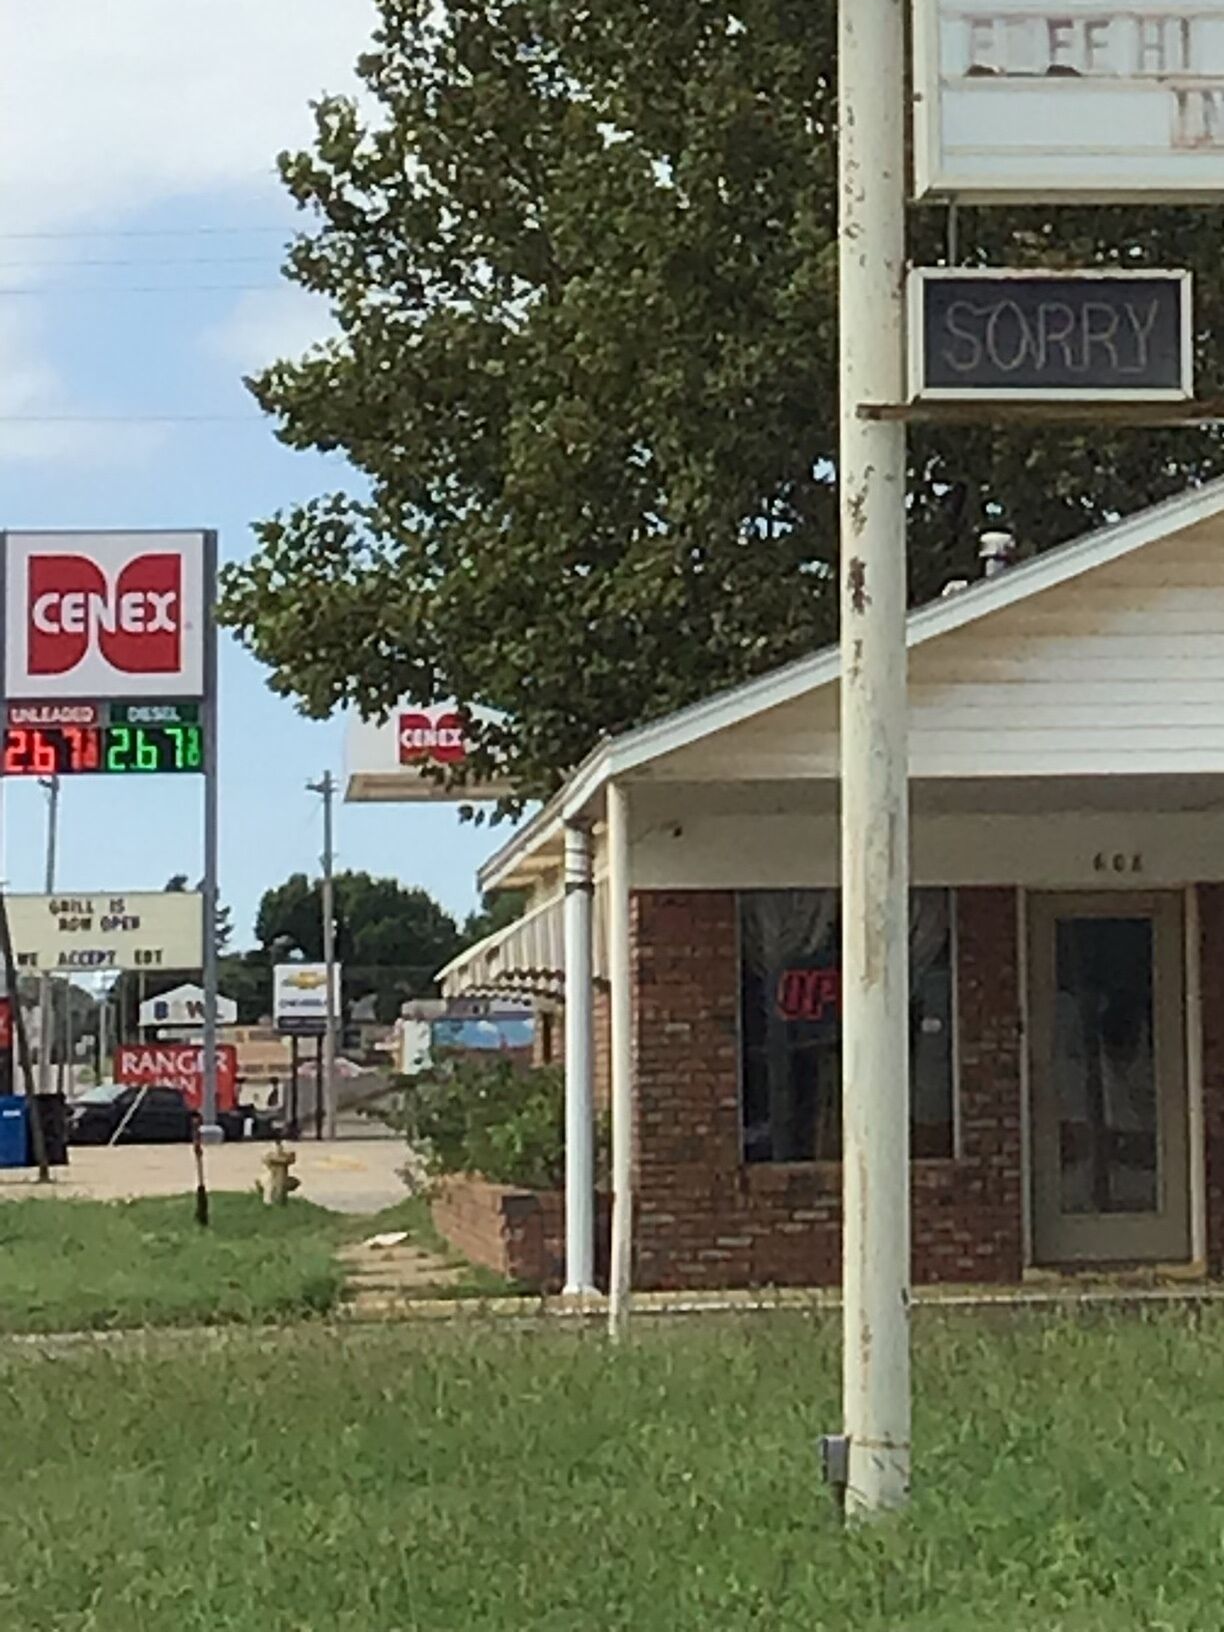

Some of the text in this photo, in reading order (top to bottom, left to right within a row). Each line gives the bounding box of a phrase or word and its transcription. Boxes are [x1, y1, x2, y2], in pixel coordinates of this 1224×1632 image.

[942, 298, 1160, 372] SORRY
[32, 591, 177, 635] CENEX
[11, 706, 94, 724] UNLEADED
[126, 706, 181, 723] DIESEL
[400, 727, 463, 749] CENEX
[49, 898, 125, 915] GRILL IS
[100, 915, 140, 932] OPEN
[17, 948, 162, 967] WE ACCEPT EBT
